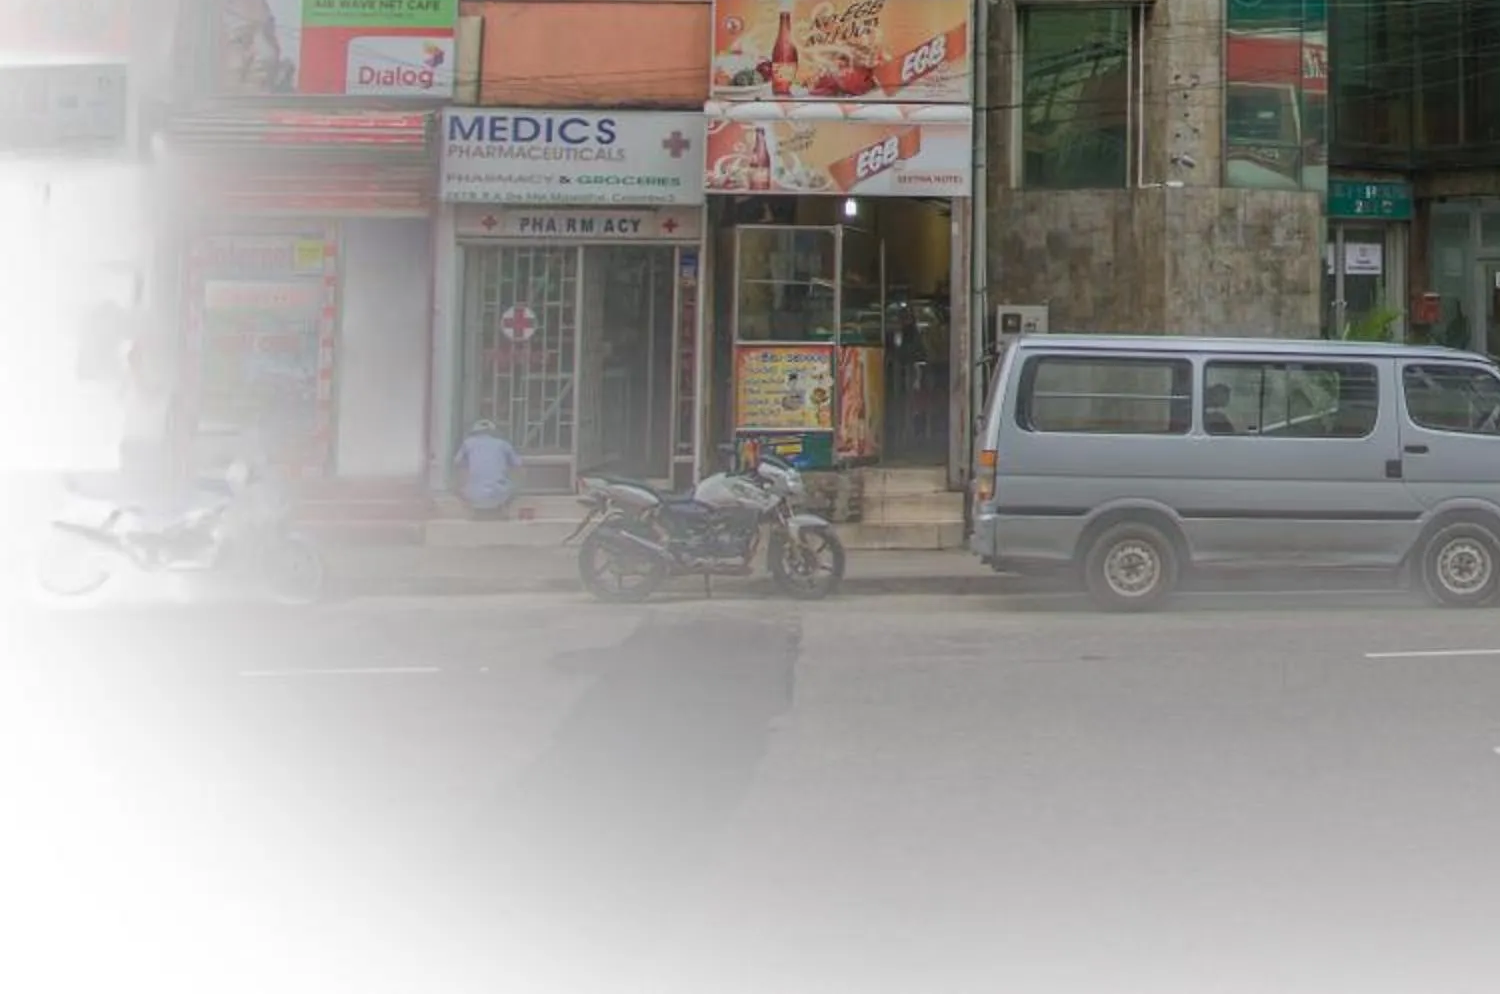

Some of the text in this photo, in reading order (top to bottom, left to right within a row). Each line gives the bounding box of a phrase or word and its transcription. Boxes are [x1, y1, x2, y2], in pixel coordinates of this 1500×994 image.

[902, 34, 946, 81] EGB
[357, 65, 434, 89] Dialog
[449, 115, 617, 145] MEDICS
[449, 144, 626, 162] PHARMACEUTICALS
[856, 135, 899, 179] EGB
[447, 172, 682, 188] PHARMACY & GROCERIES
